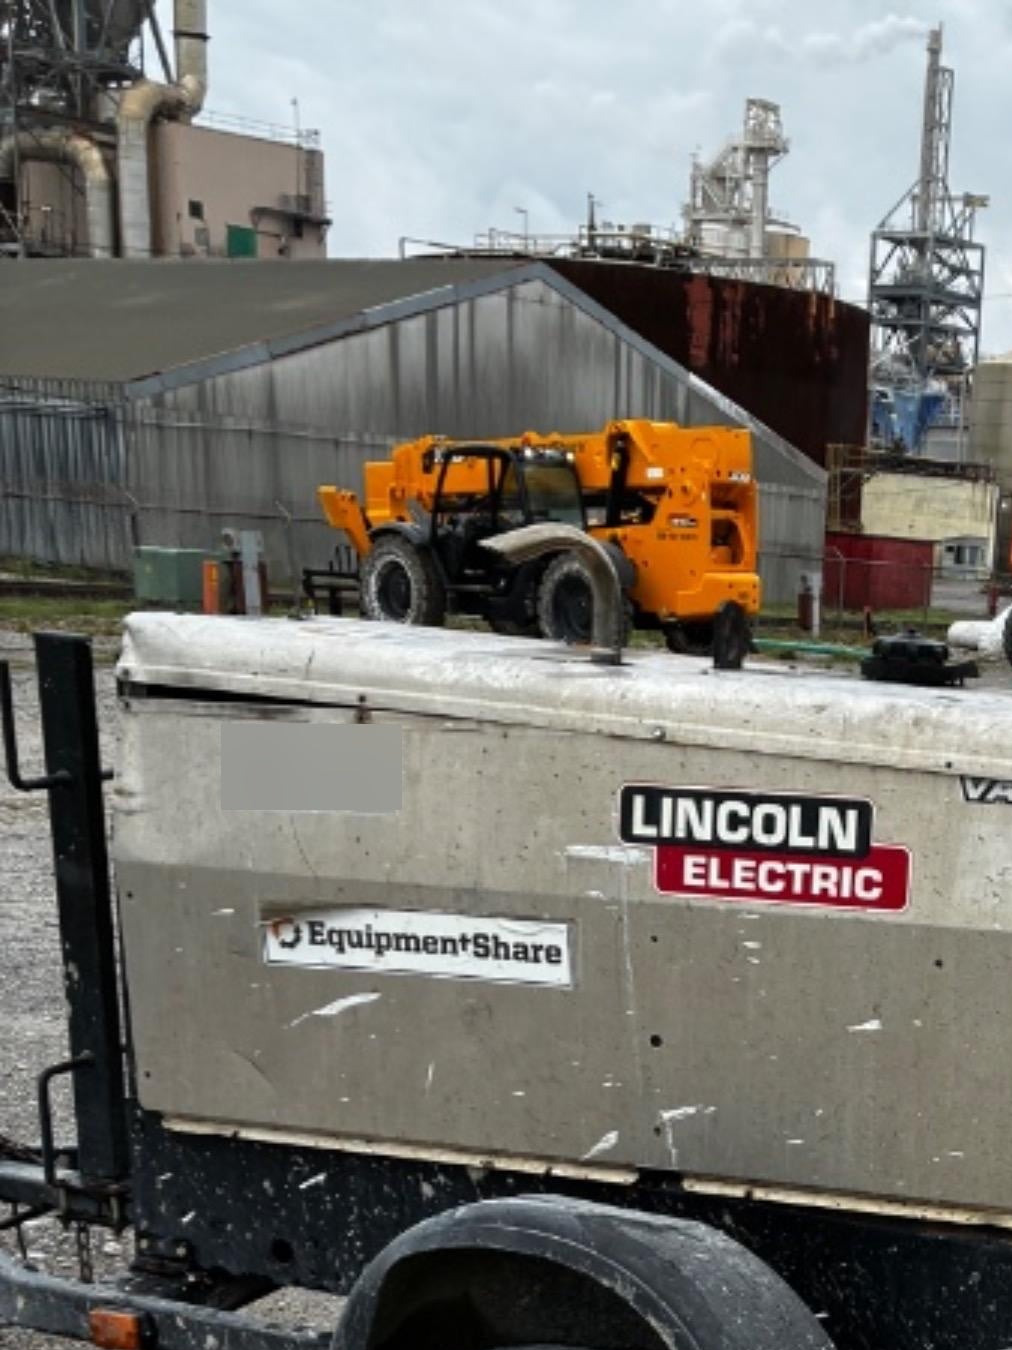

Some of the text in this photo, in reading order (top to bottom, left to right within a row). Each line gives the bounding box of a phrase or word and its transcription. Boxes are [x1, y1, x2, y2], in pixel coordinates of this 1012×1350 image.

[632, 795, 859, 851] LINCOLN
[683, 854, 884, 900] ELECTRIC
[307, 920, 562, 964] EquipmentShare
